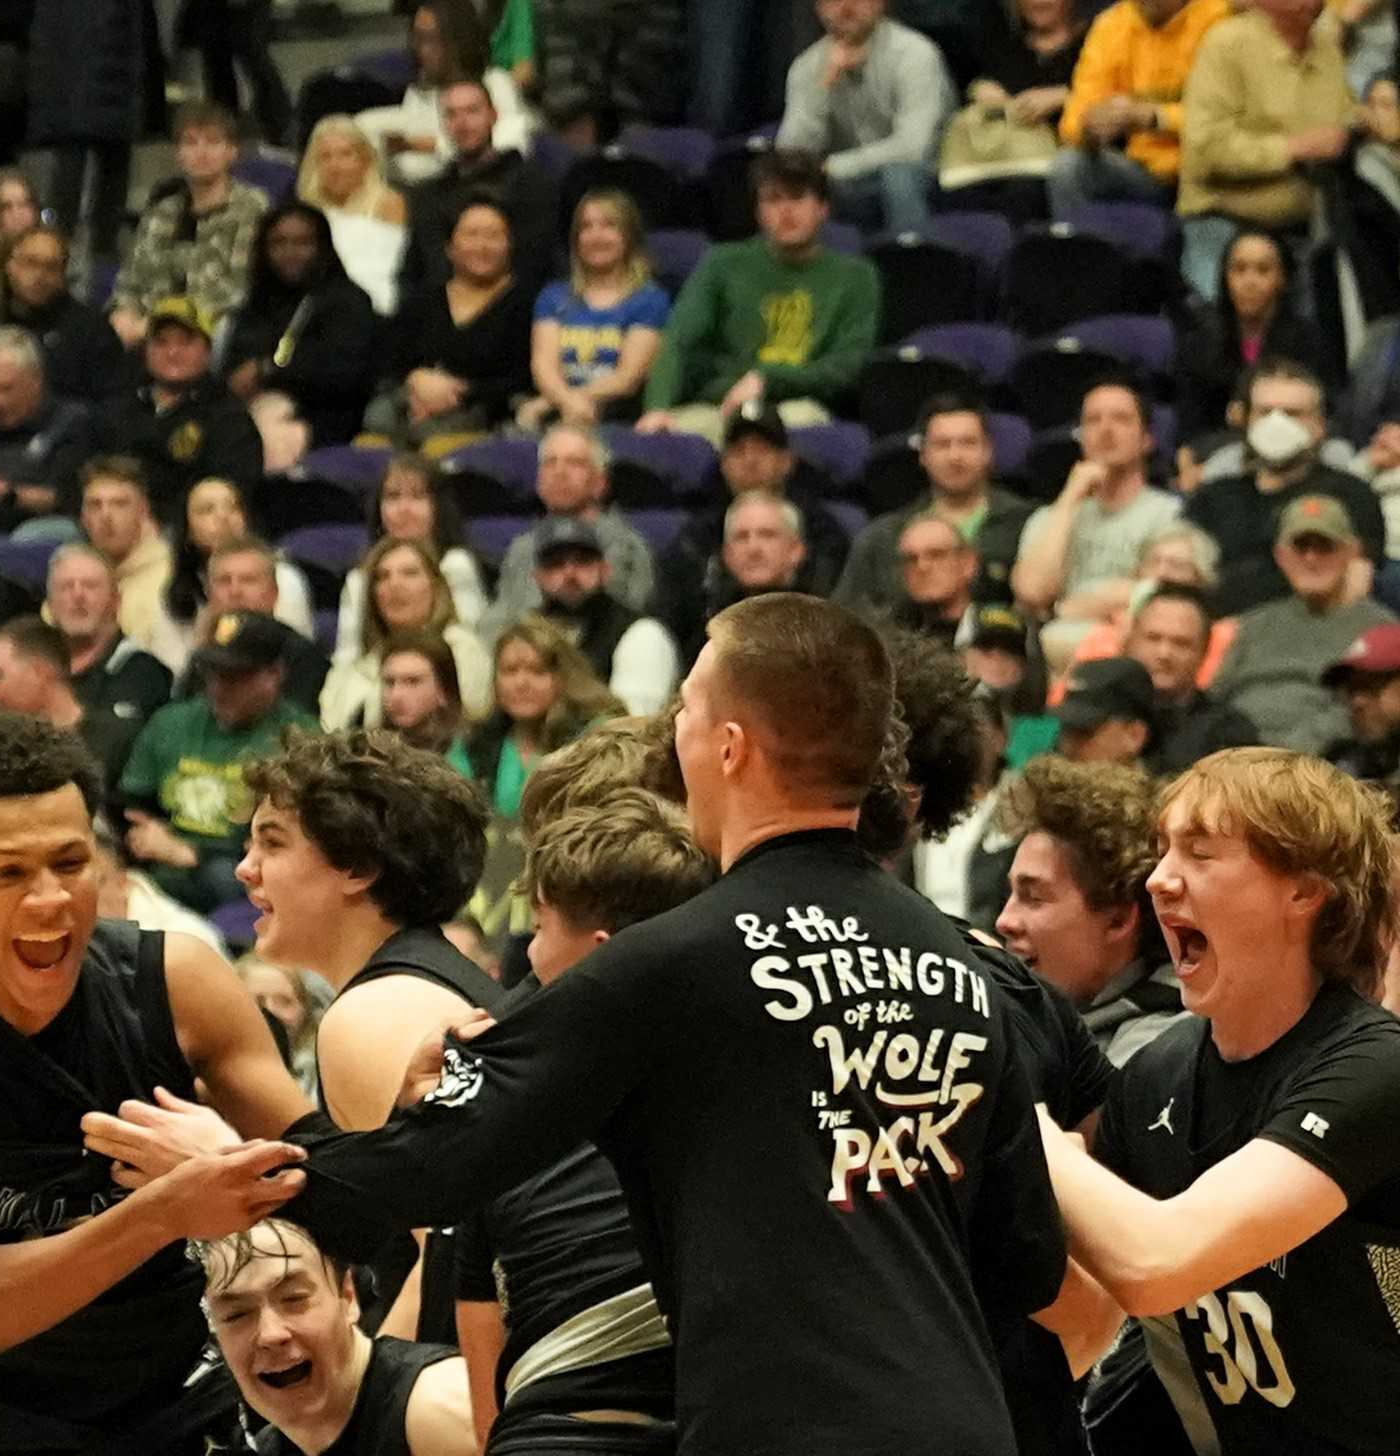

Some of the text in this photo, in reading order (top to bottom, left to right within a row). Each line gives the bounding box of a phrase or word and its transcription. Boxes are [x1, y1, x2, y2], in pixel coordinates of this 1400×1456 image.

[734, 905, 870, 950] & the
[750, 946, 990, 1022] STRENGTH
[843, 999, 915, 1031] of the
[812, 1025, 988, 1106] WOLF
[811, 1090, 828, 1107] IS
[818, 1109, 853, 1130] THE
[827, 1085, 984, 1210] PACK
[1184, 1290, 1297, 1409] 30
